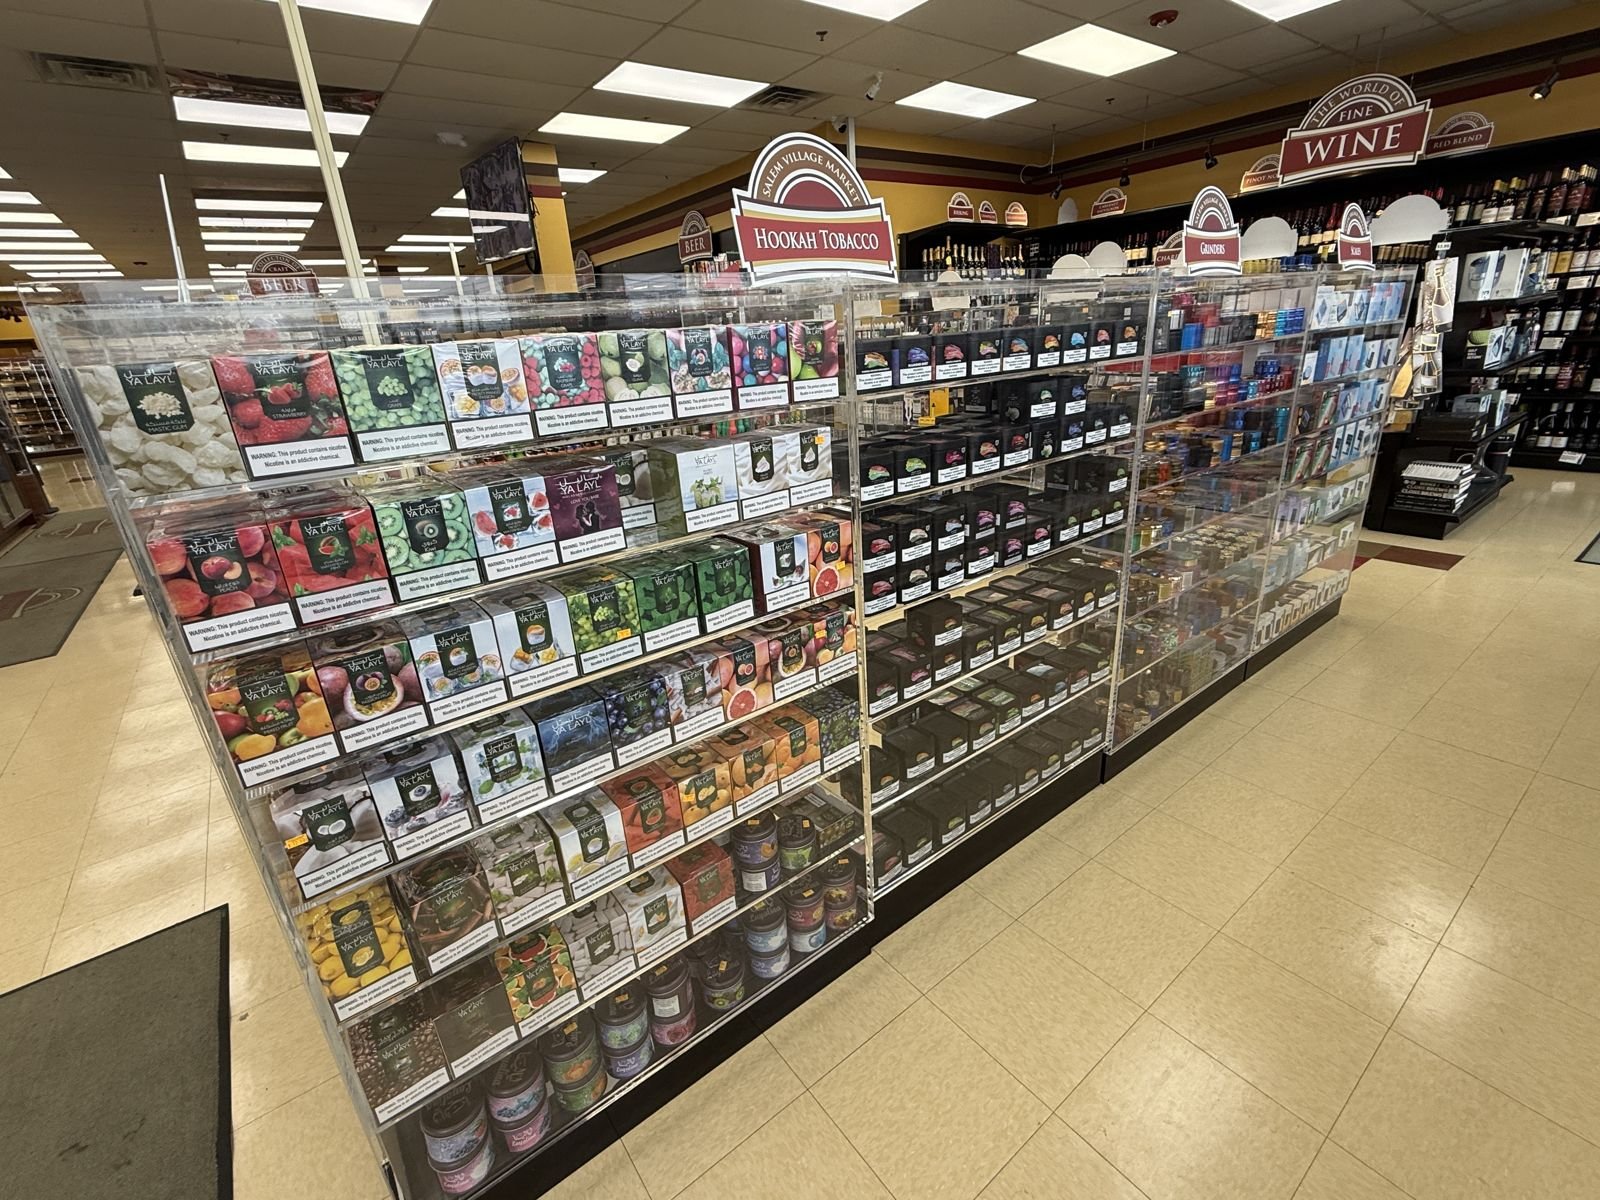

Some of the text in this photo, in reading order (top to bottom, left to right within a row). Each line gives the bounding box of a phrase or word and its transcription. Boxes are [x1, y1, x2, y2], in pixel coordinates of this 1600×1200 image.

[1311, 82, 1406, 123] THE WORLD OF
[1339, 105, 1373, 122] FINE
[1303, 122, 1404, 164] WINE
[1433, 134, 1482, 149] RED BLEND
[762, 151, 860, 202] SALEM VILLAGE MARKET
[685, 237, 705, 254] BEER
[754, 228, 879, 250] HOOKAH TOBACCO
[1200, 242, 1225, 254] GRINDERS
[256, 256, 290, 270] COLLECTION
[262, 278, 305, 292] BEER
[256, 366, 298, 375] YA LAYL
[126, 376, 176, 386] YA LAYL
[395, 435, 410, 443] product
[251, 452, 276, 460] WARNING:
[561, 481, 601, 494] YA LAYL
[321, 526, 343, 534] LAYL
[209, 543, 236, 552] LAYL
[400, 578, 419, 586] WARNING:
[430, 573, 444, 581] product
[301, 600, 323, 608] WARNING:
[336, 594, 352, 602] product
[362, 594, 379, 603] chemical.
[189, 626, 215, 636] WARNING:
[229, 619, 247, 628] product
[249, 615, 269, 623] contains
[238, 625, 259, 633] addictive
[260, 620, 281, 628] chemical.
[364, 660, 383, 669] LAYL
[248, 687, 286, 702] YA LAYL
[345, 730, 365, 740] WARNING:
[376, 721, 390, 730] product
[391, 716, 407, 724] contains
[356, 736, 371, 744] Nicotine
[383, 726, 399, 734] addictive
[400, 720, 416, 728] chemical.
[554, 718, 590, 736] YA LAYL
[243, 763, 266, 773] WARNING:
[280, 753, 296, 762] product
[297, 747, 315, 755] contains
[316, 741, 332, 749] nicotine.
[256, 768, 274, 776] Nicotine
[288, 757, 306, 766] addictive
[307, 750, 325, 759] chemical.
[400, 774, 431, 788] YA LAYL
[325, 806, 343, 816] LAYL
